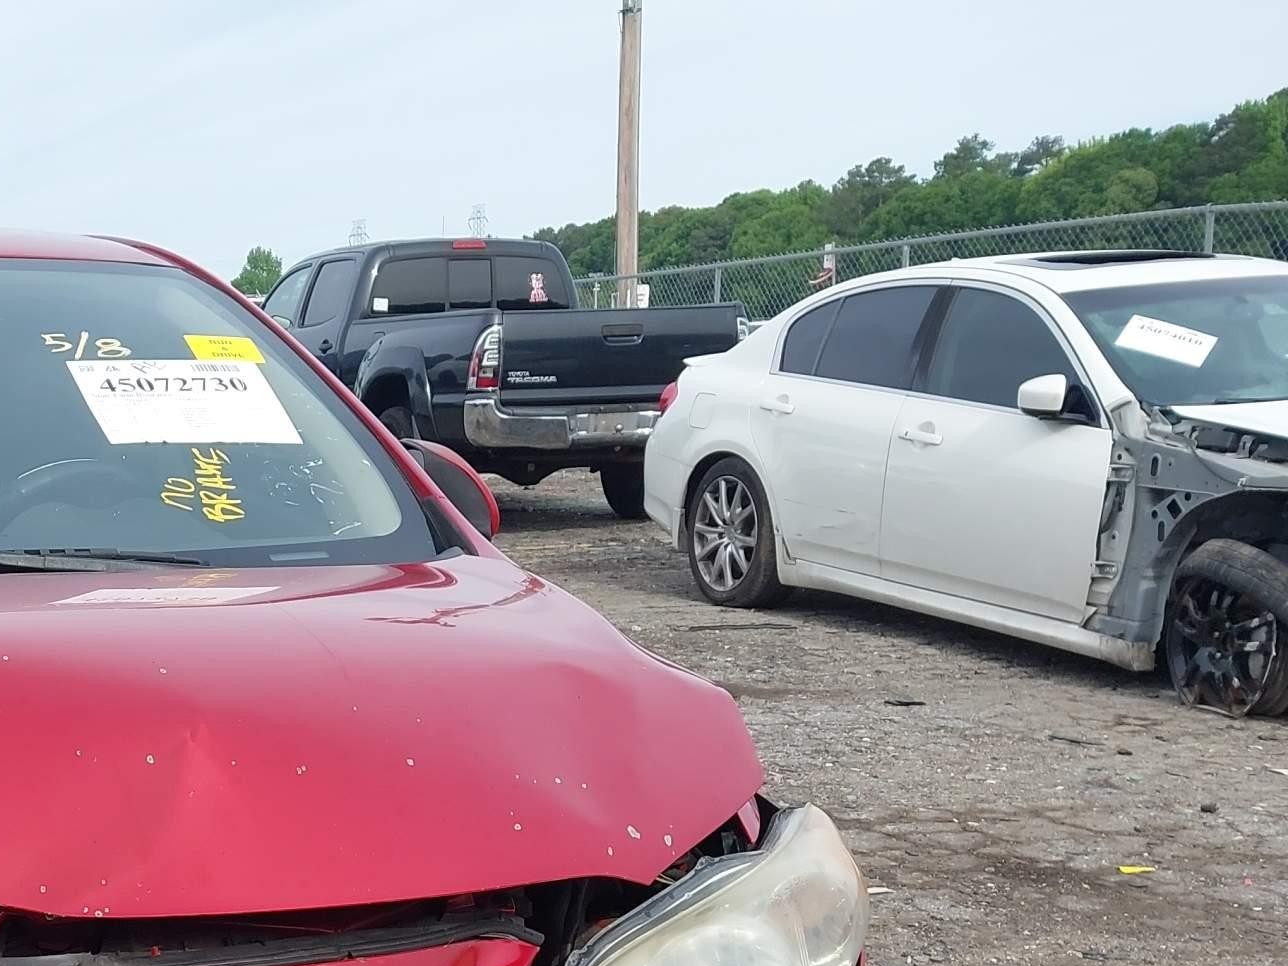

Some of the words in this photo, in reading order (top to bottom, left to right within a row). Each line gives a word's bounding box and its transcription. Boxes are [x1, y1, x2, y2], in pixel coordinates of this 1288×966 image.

[40, 330, 132, 360] 5/8
[99, 376, 248, 393] 45072730
[507, 375, 558, 383] TACOMA
